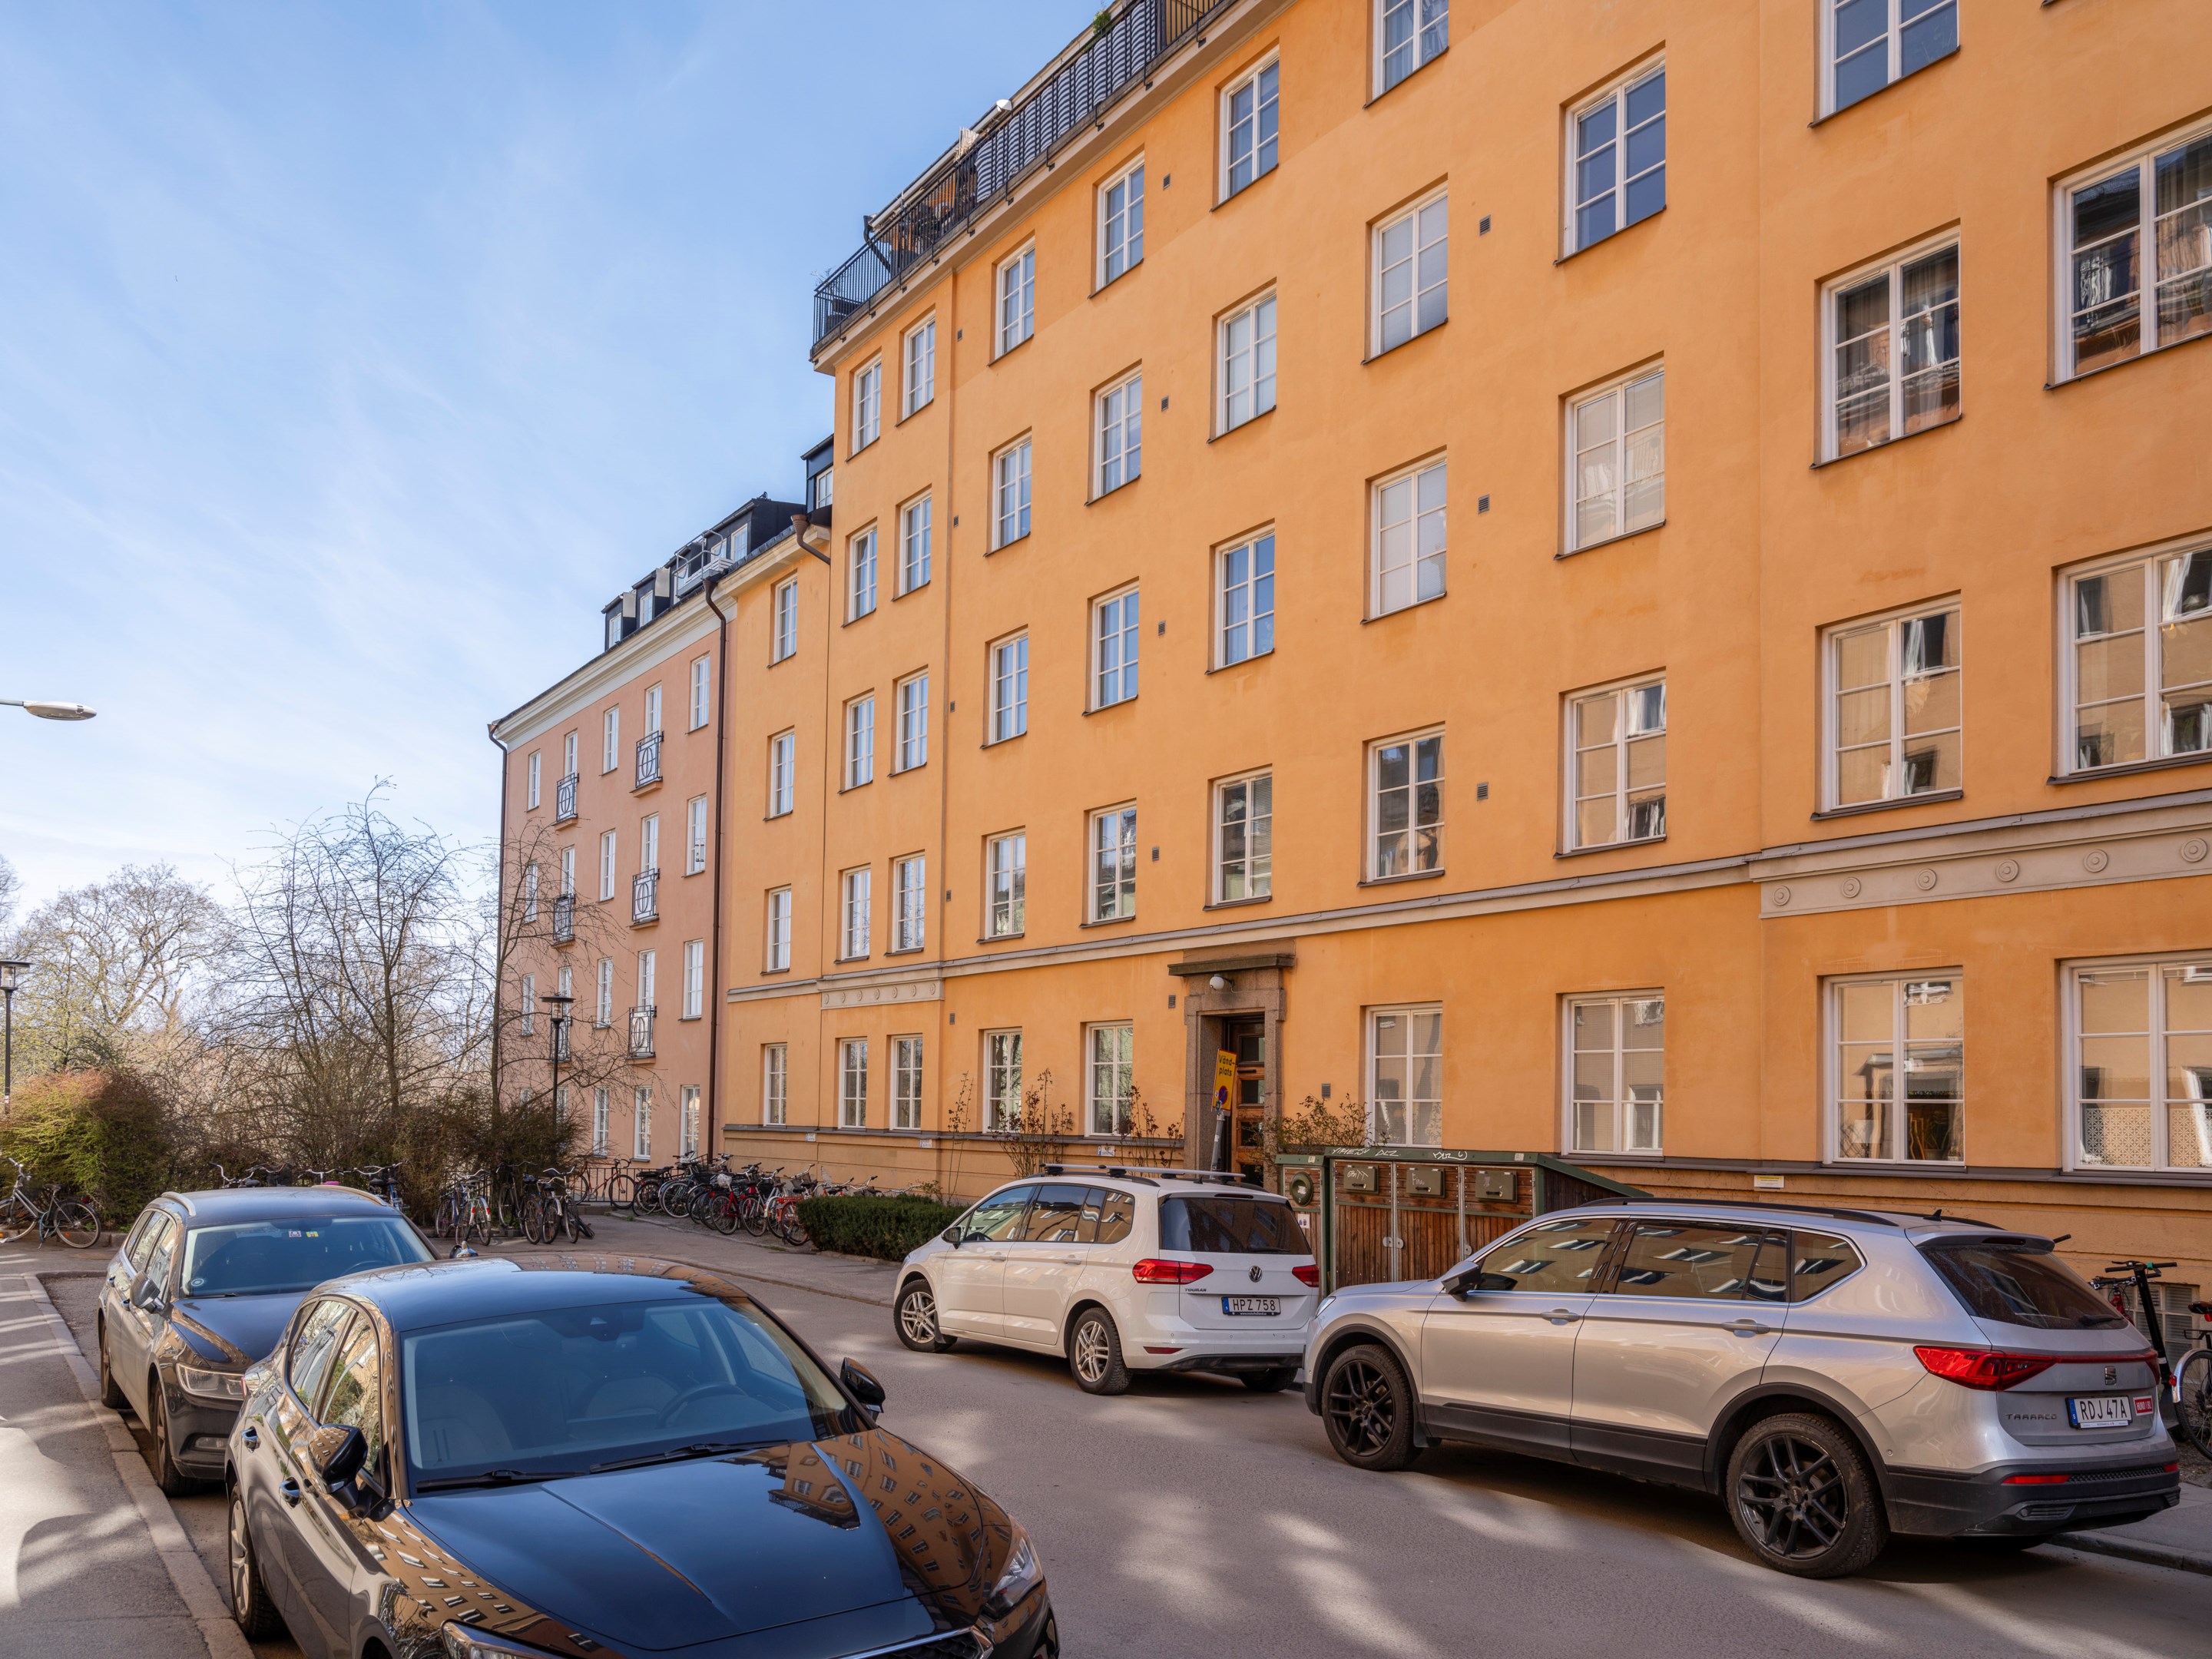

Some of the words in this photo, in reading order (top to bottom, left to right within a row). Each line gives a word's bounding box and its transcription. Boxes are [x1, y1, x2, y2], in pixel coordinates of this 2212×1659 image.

[1219, 1055, 1235, 1066] Vänd-
[1219, 1066, 1232, 1077] plats
[1233, 1299, 1253, 1310] HPZ
[1256, 1300, 1276, 1310] 758
[2079, 1399, 2103, 1420] RDJ
[2106, 1399, 2128, 1419] 47A
